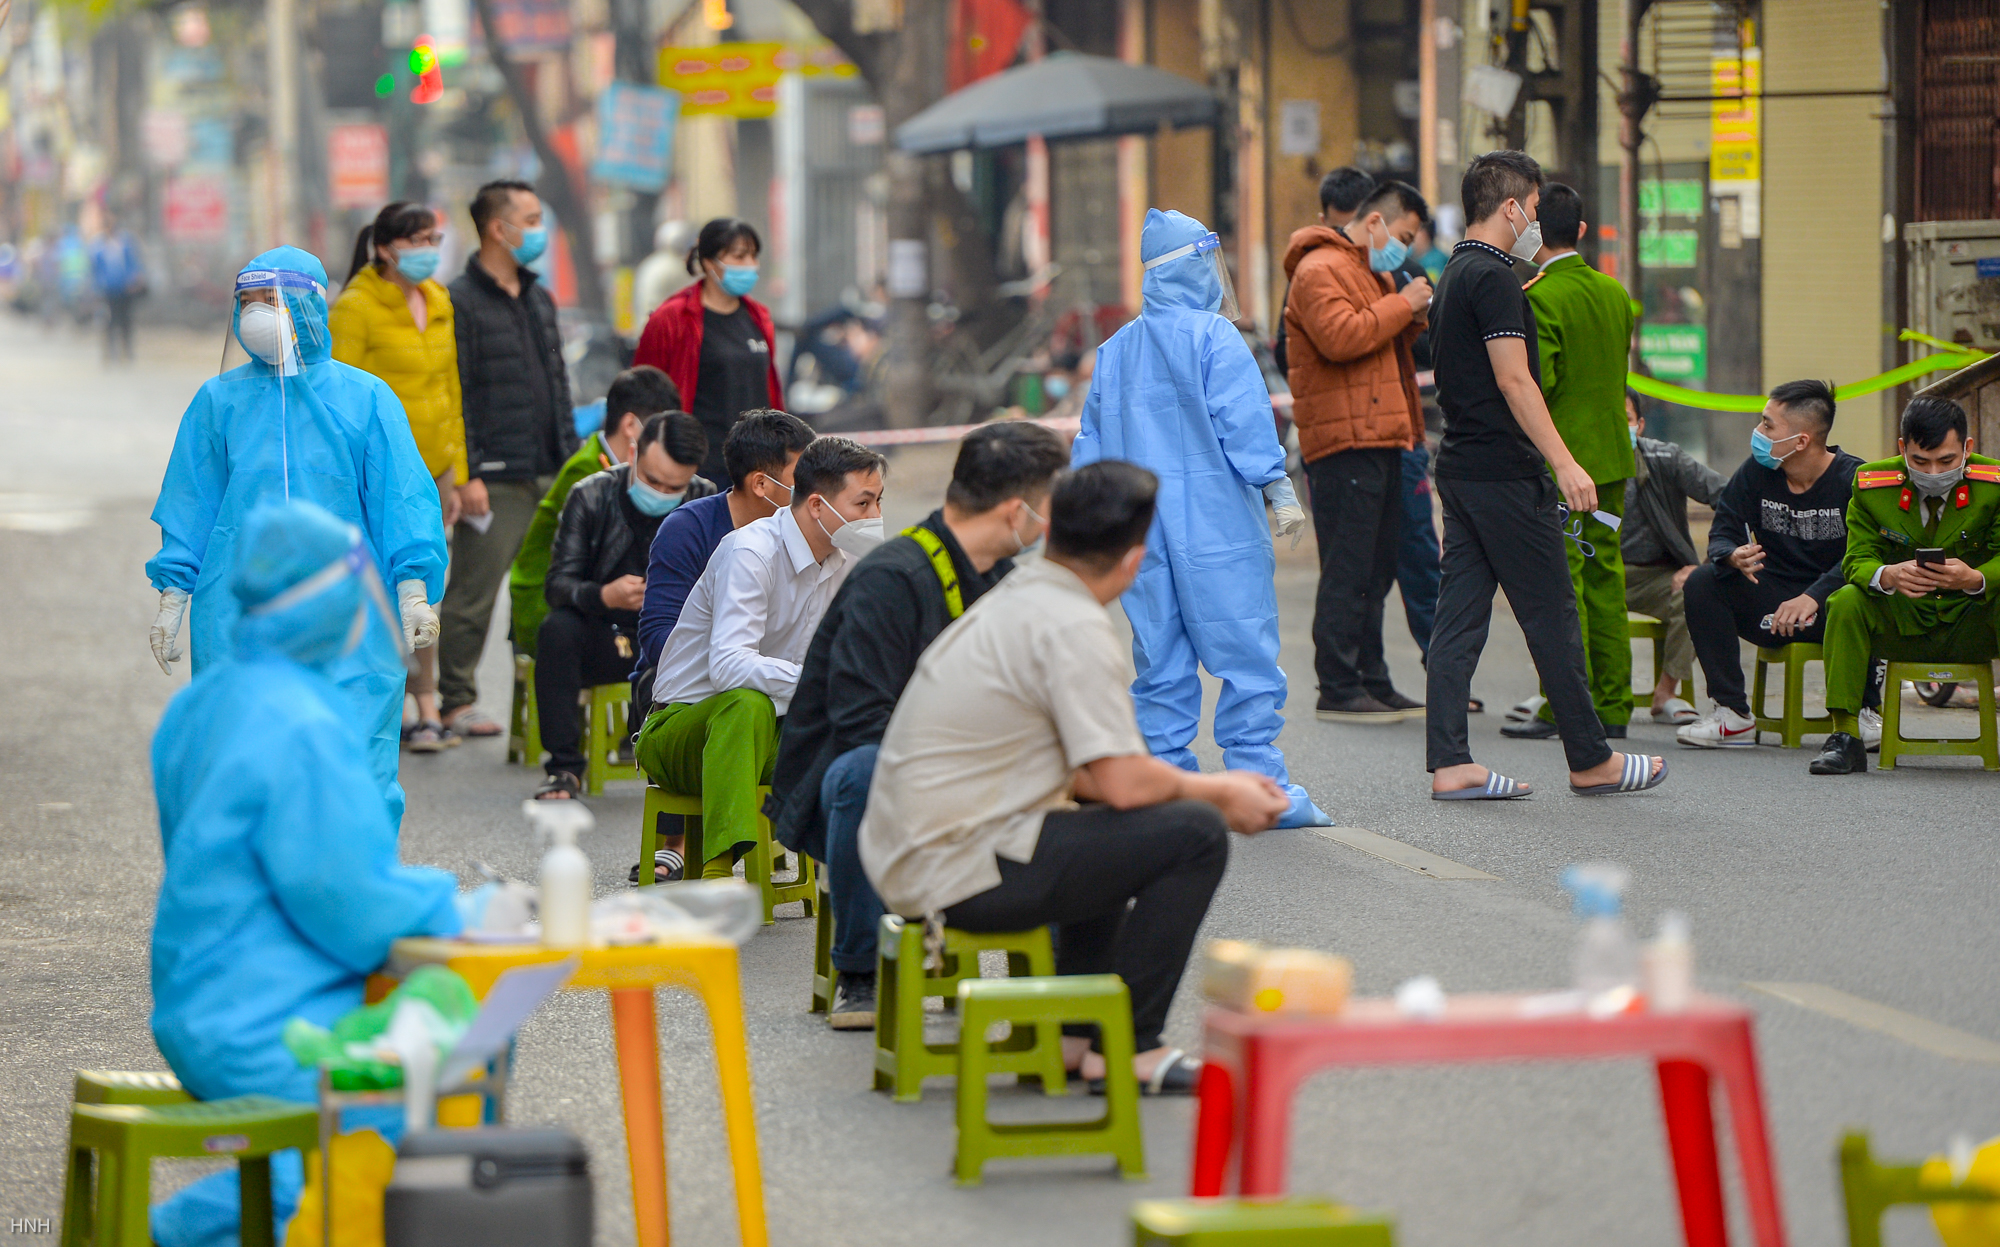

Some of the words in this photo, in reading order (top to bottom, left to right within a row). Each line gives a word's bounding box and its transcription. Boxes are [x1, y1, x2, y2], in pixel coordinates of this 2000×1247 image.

[251, 272, 267, 280] Shield
[1790, 508, 1817, 518] LEEP
[1818, 508, 1830, 517] ON
